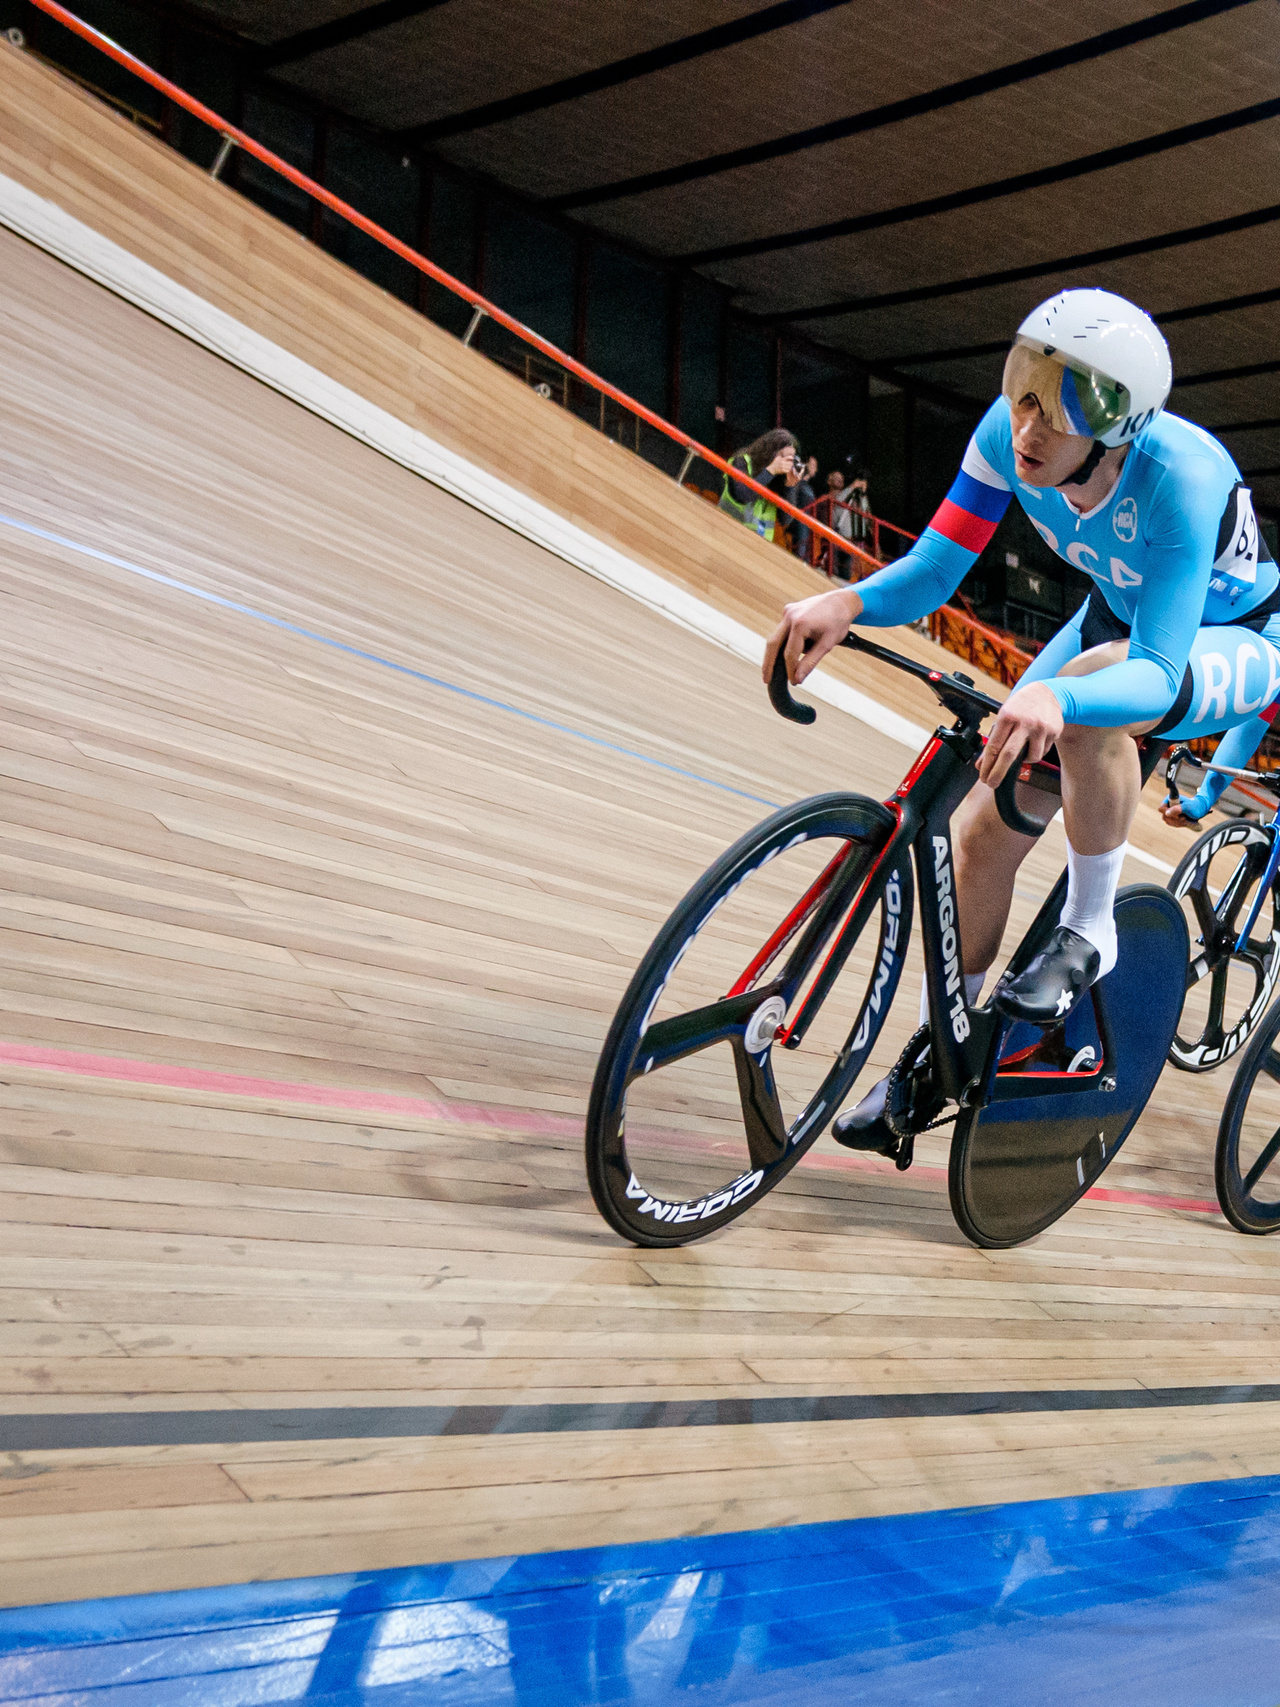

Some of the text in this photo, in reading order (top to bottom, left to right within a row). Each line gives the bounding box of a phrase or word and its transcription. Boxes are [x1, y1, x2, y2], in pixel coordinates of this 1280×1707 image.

[1119, 407, 1155, 438] KA
[851, 868, 902, 1052] ORIMA
[932, 835, 971, 1044] ARGON 18
[625, 1169, 765, 1224] CORIMA
